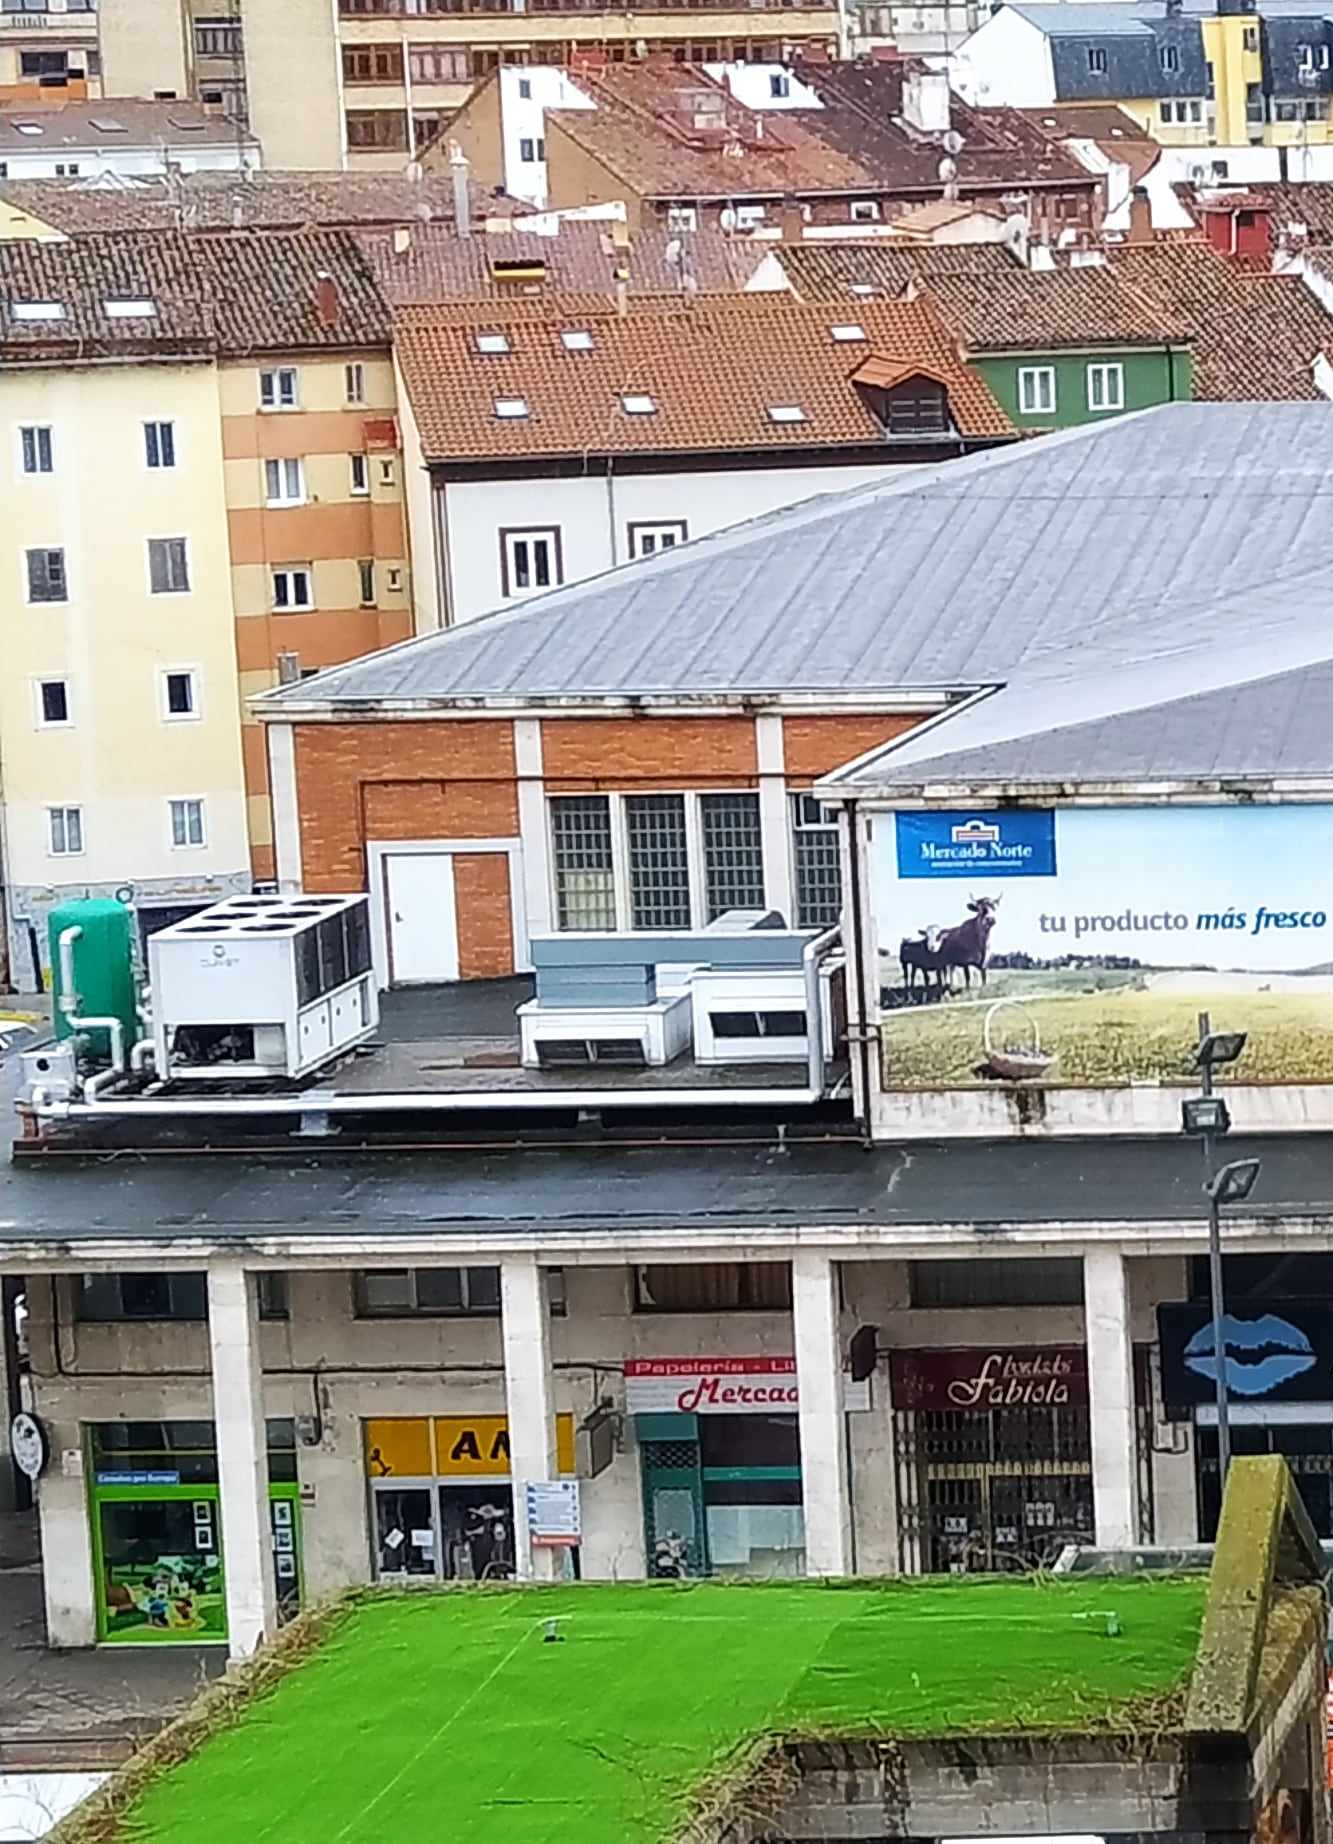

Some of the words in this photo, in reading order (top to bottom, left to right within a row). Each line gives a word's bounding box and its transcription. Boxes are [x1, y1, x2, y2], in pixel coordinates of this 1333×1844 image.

[921, 841, 987, 860] Mercado
[990, 841, 1033, 859] Norte
[1038, 912, 1067, 933] tu
[1074, 908, 1189, 939] producto
[1195, 906, 1247, 930] más
[1251, 906, 1327, 936] fresco
[634, 1360, 744, 1375] Papelería
